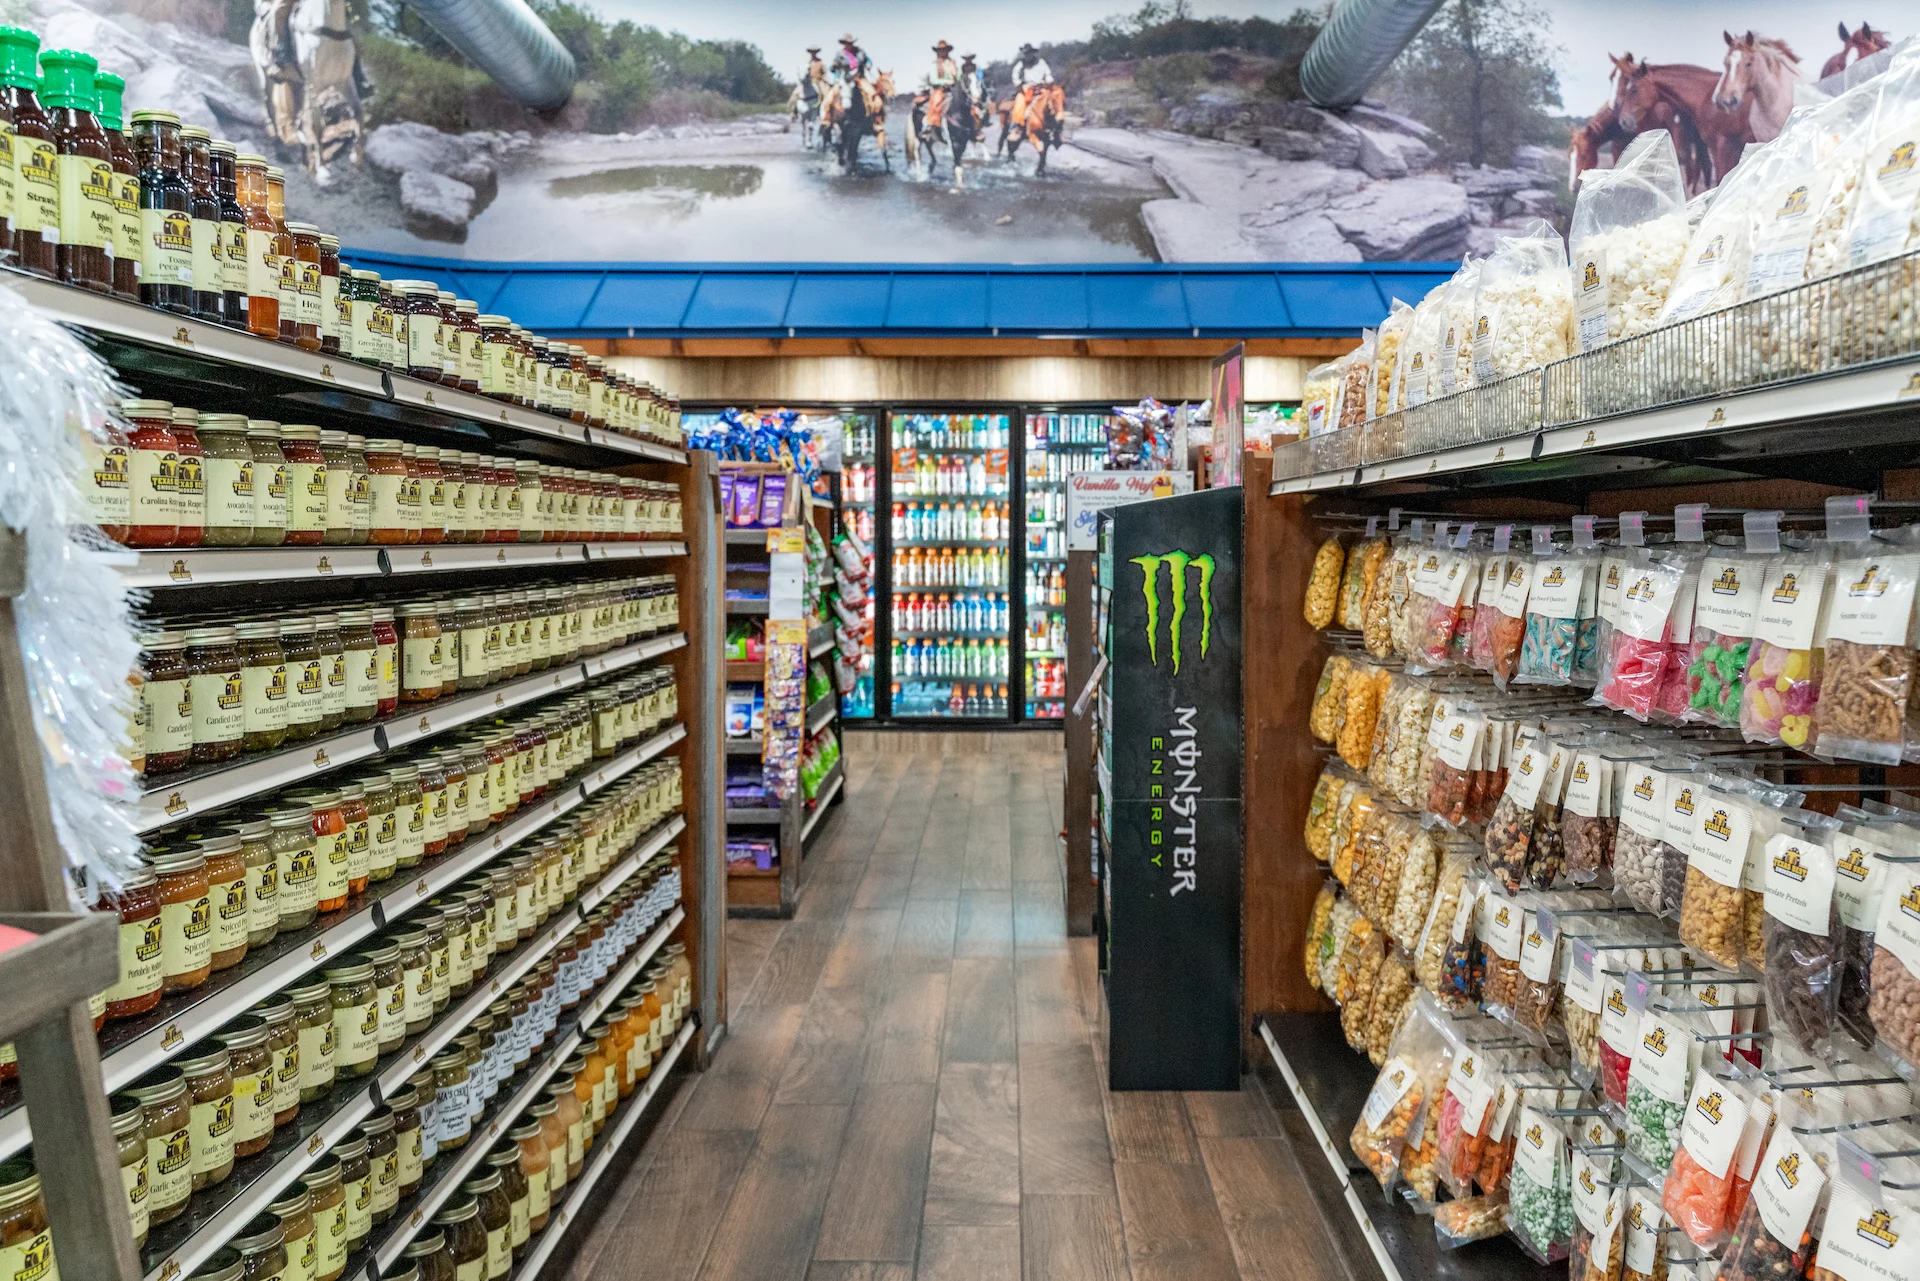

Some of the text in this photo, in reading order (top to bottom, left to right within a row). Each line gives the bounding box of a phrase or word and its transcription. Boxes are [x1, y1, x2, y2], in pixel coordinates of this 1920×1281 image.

[1073, 476, 1120, 491] Vanilla
[1151, 737, 1163, 867] ENERGY
[1169, 706, 1202, 897] MONSTER
[1786, 893, 1808, 907] Pretzels
[220, 920, 240, 933] Spiced
[184, 941, 206, 954] Spiced
